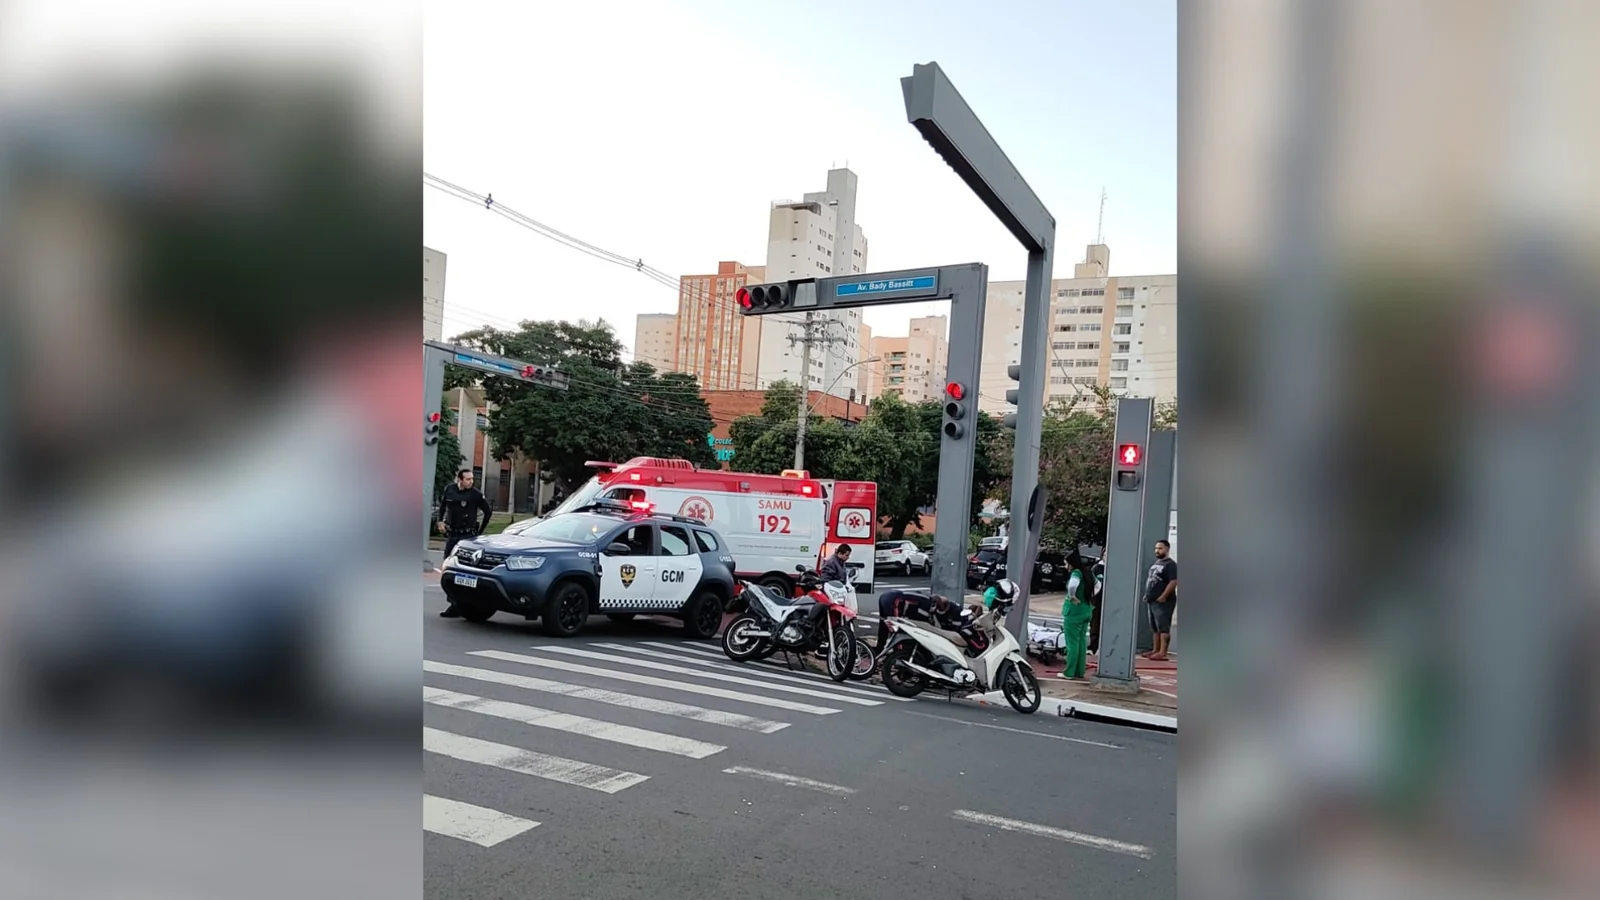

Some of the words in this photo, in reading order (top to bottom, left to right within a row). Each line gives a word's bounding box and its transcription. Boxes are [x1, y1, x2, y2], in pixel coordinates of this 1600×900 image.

[869, 282, 886, 290] Bady
[888, 280, 914, 288] Bassitt
[758, 499, 792, 511] SAMU
[758, 514, 791, 534] 192
[661, 569, 685, 583] GCM
